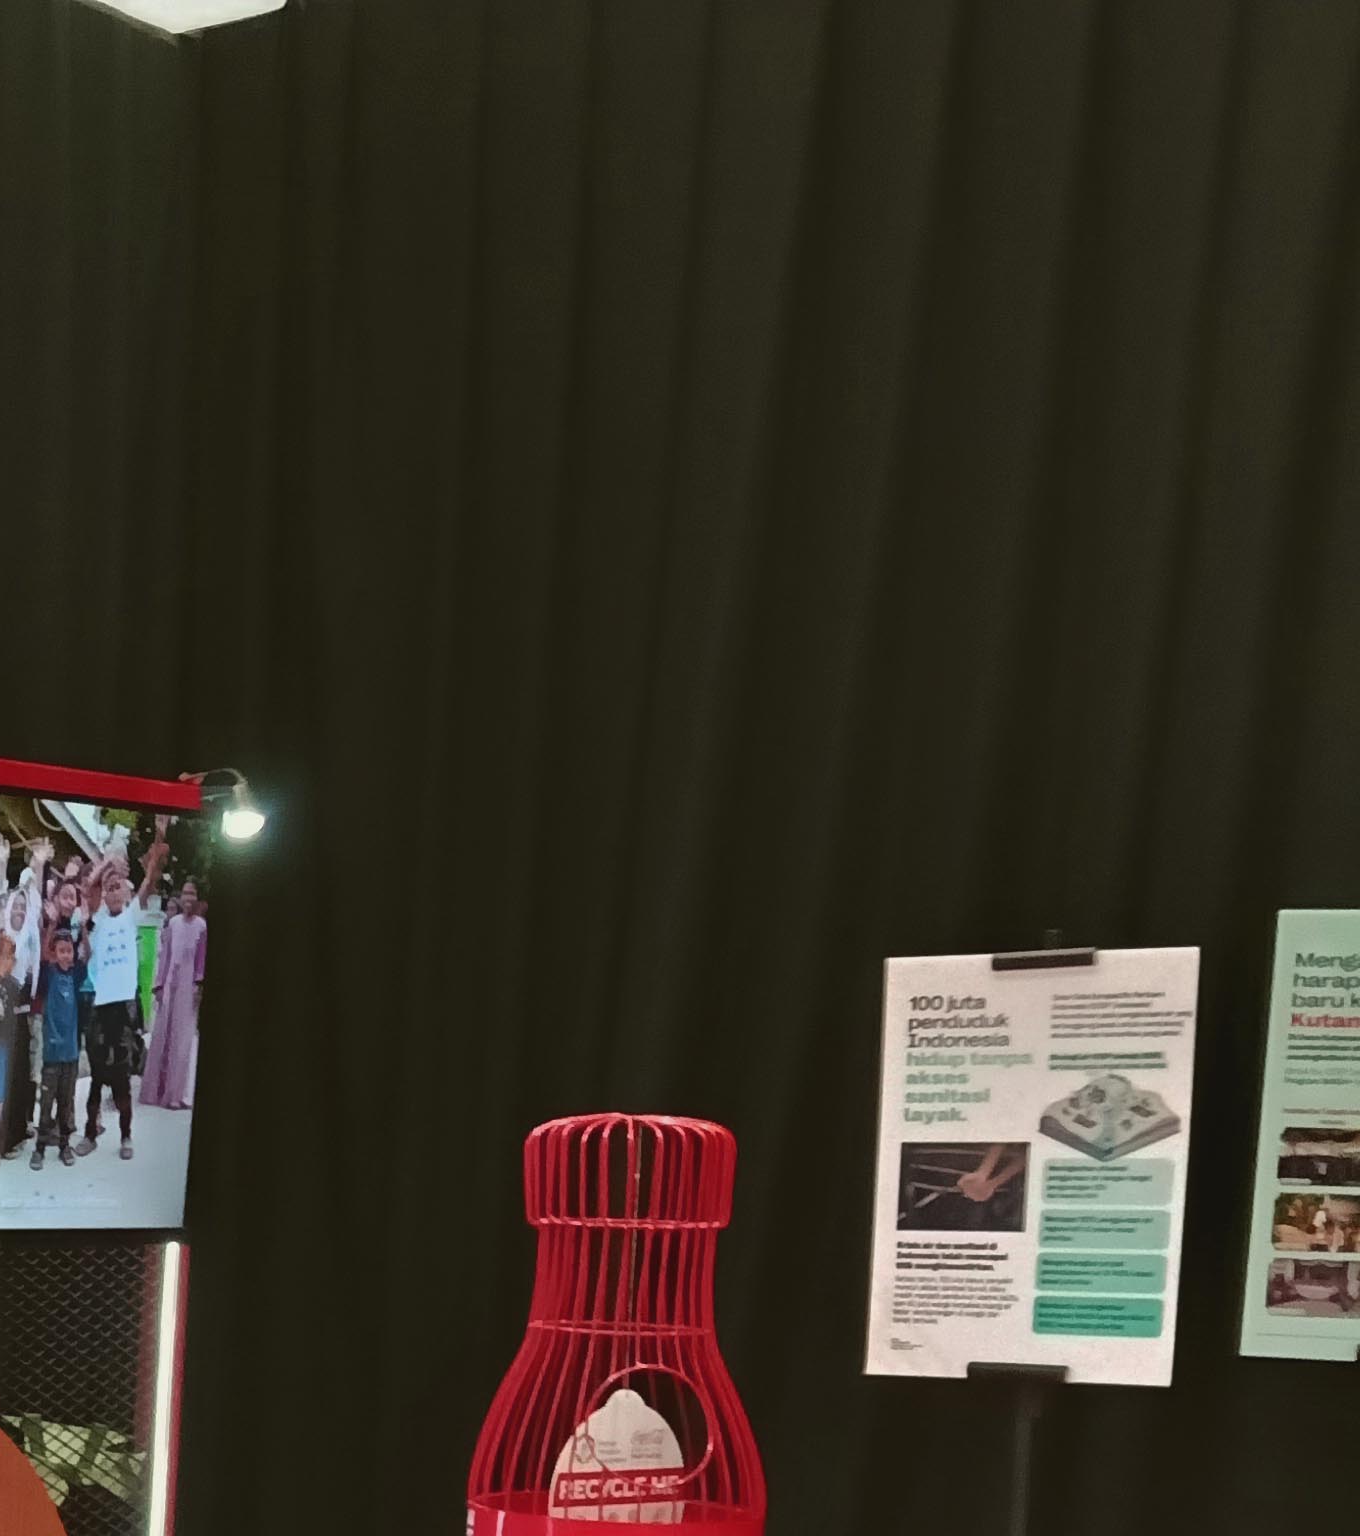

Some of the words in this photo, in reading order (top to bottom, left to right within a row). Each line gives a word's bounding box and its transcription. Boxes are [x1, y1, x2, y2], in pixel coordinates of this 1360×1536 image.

[909, 995, 943, 1011] 100
[945, 995, 986, 1013] juta
[908, 1014, 1008, 1032] penduduk
[907, 1033, 1009, 1048] Indonesia
[906, 1071, 970, 1085] akses
[559, 1477, 648, 1500] RECYCLE
